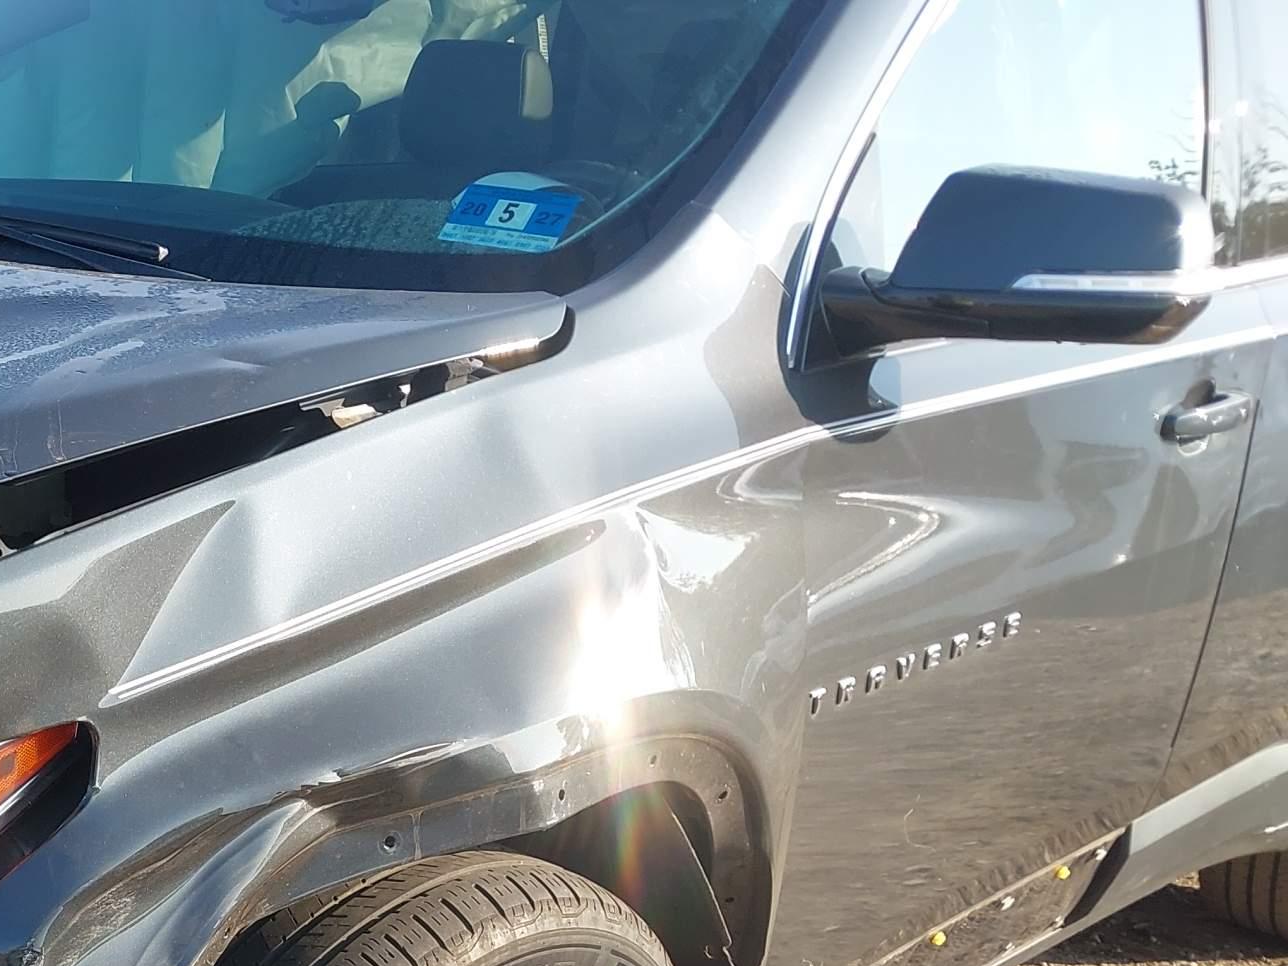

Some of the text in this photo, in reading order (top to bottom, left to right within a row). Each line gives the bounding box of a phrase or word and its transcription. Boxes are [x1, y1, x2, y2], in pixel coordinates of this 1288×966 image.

[460, 201, 565, 226] 20 5 27
[808, 611, 1023, 717] TRAVERSE
